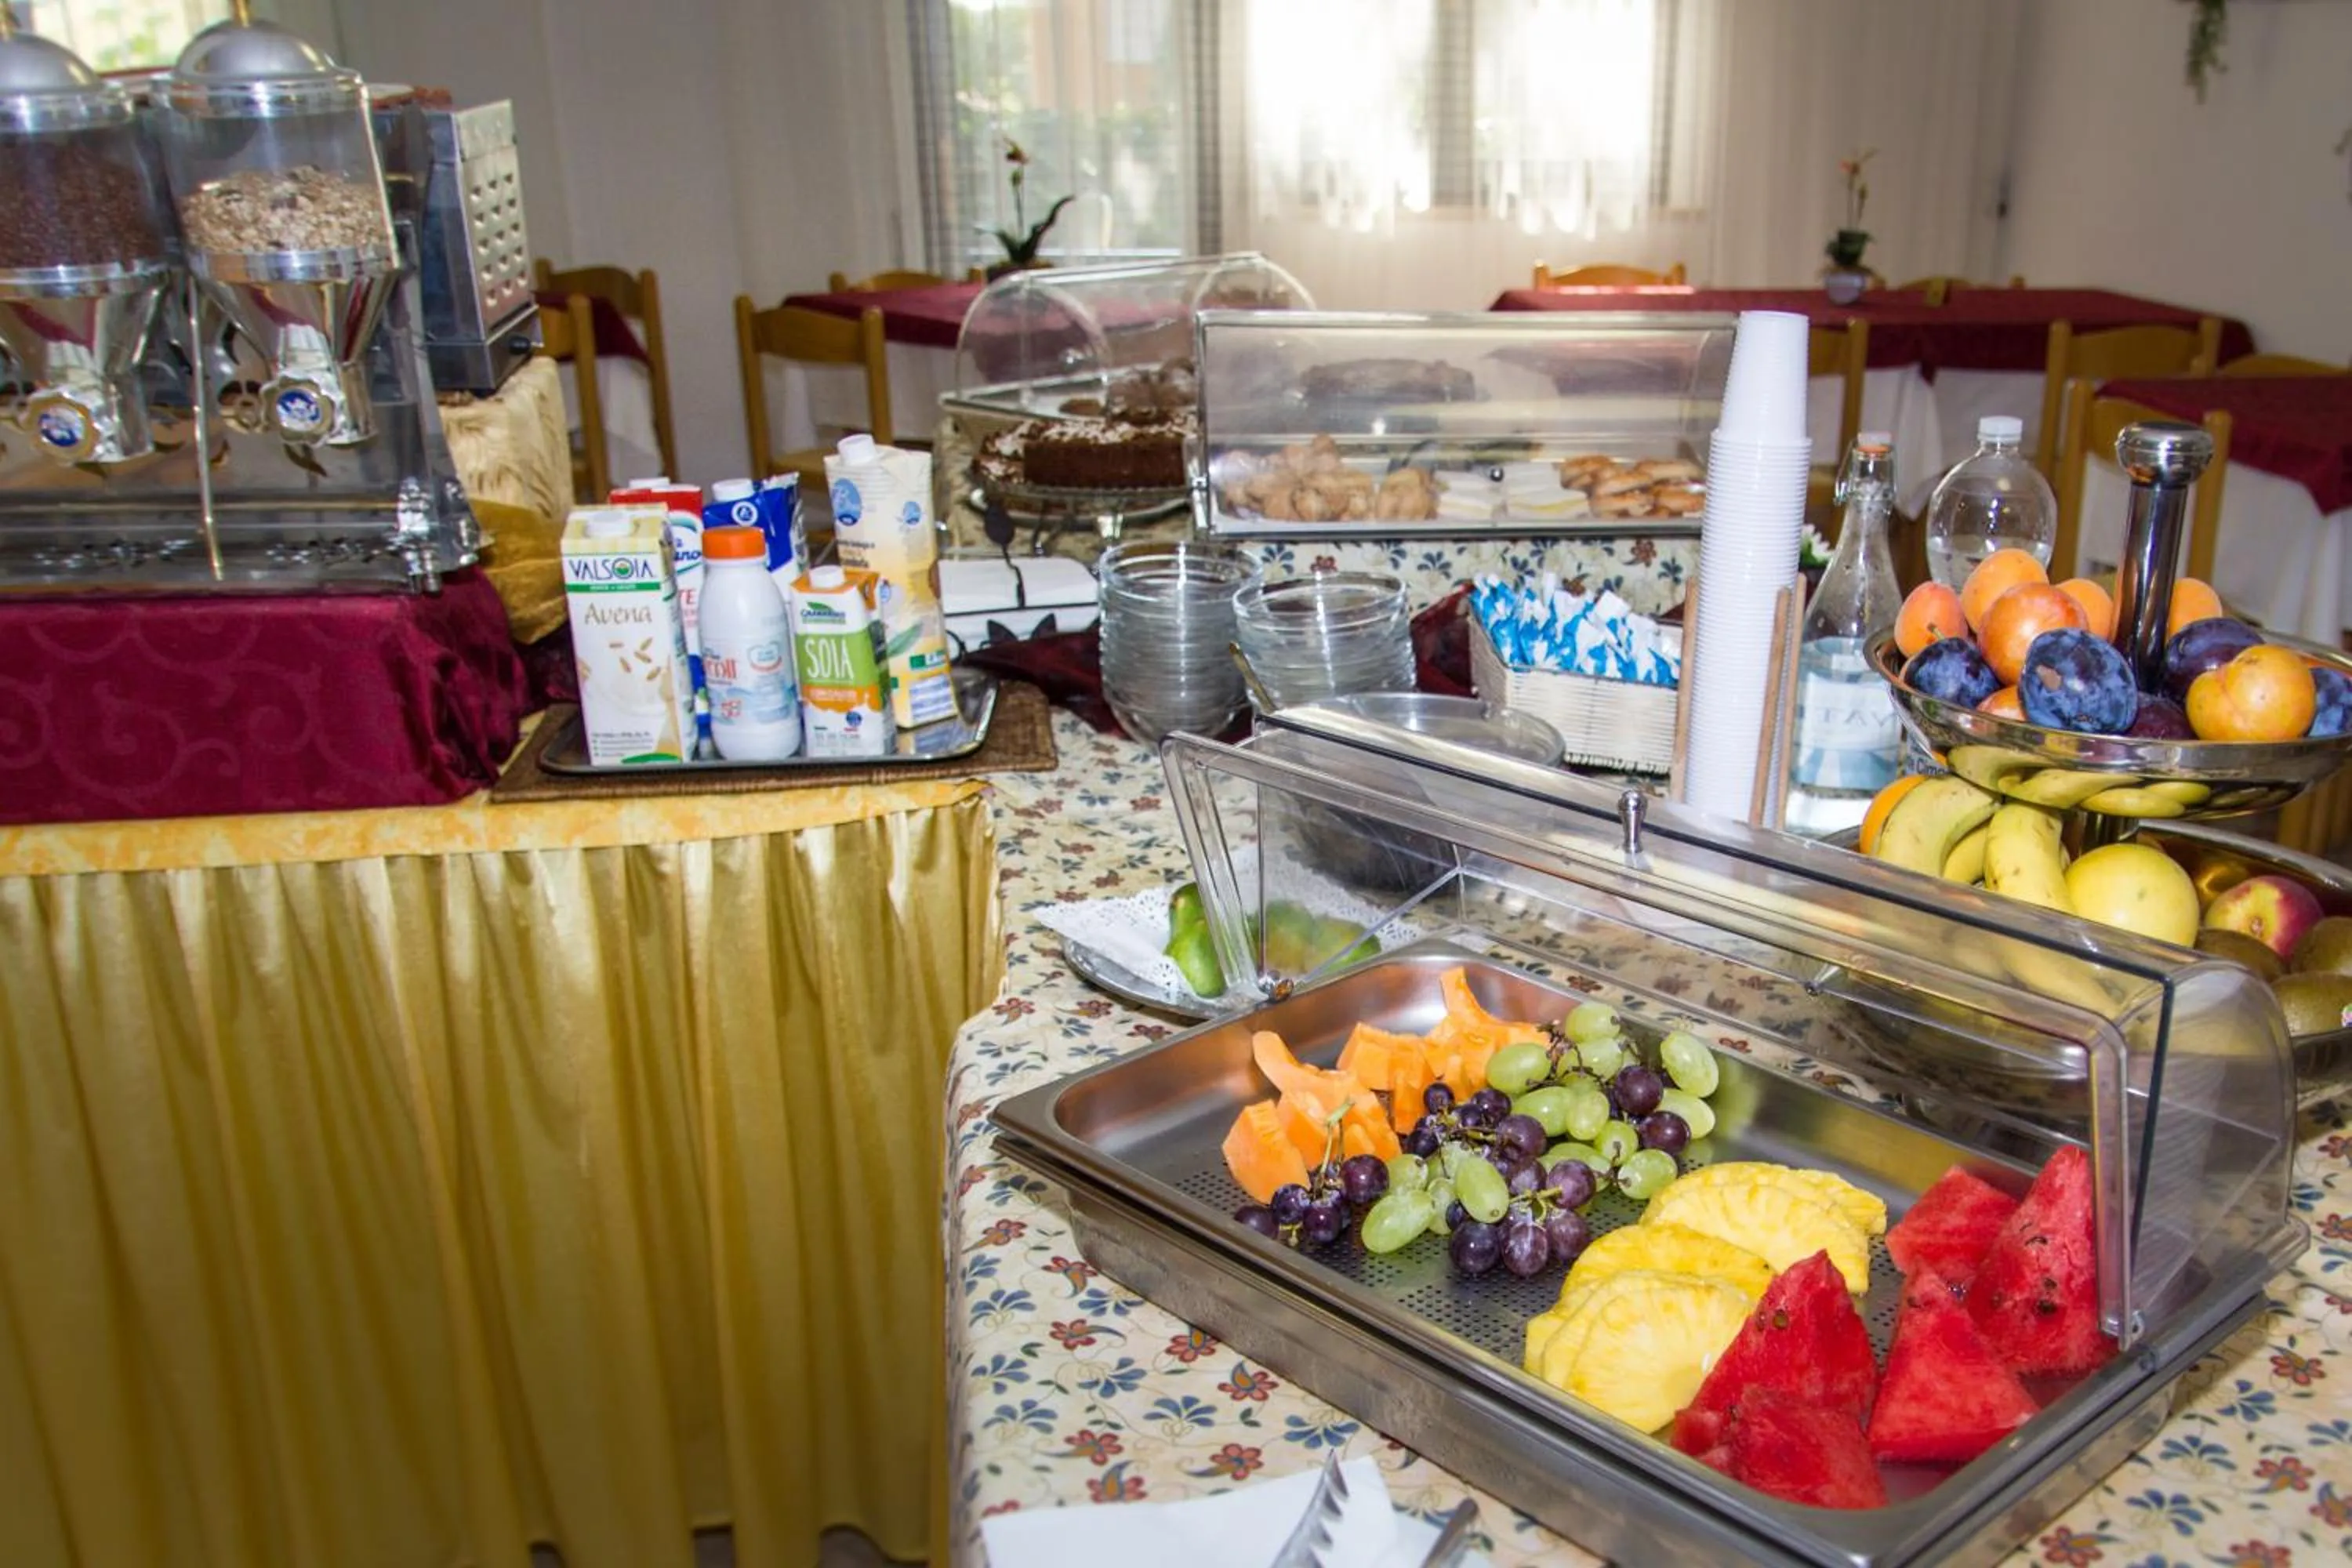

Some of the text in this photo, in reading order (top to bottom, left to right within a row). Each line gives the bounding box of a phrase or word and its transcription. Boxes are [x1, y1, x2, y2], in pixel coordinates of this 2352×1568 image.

[568, 557, 655, 581] VALSOIA
[584, 602, 652, 625] Avena
[804, 637, 855, 679] SOIA
